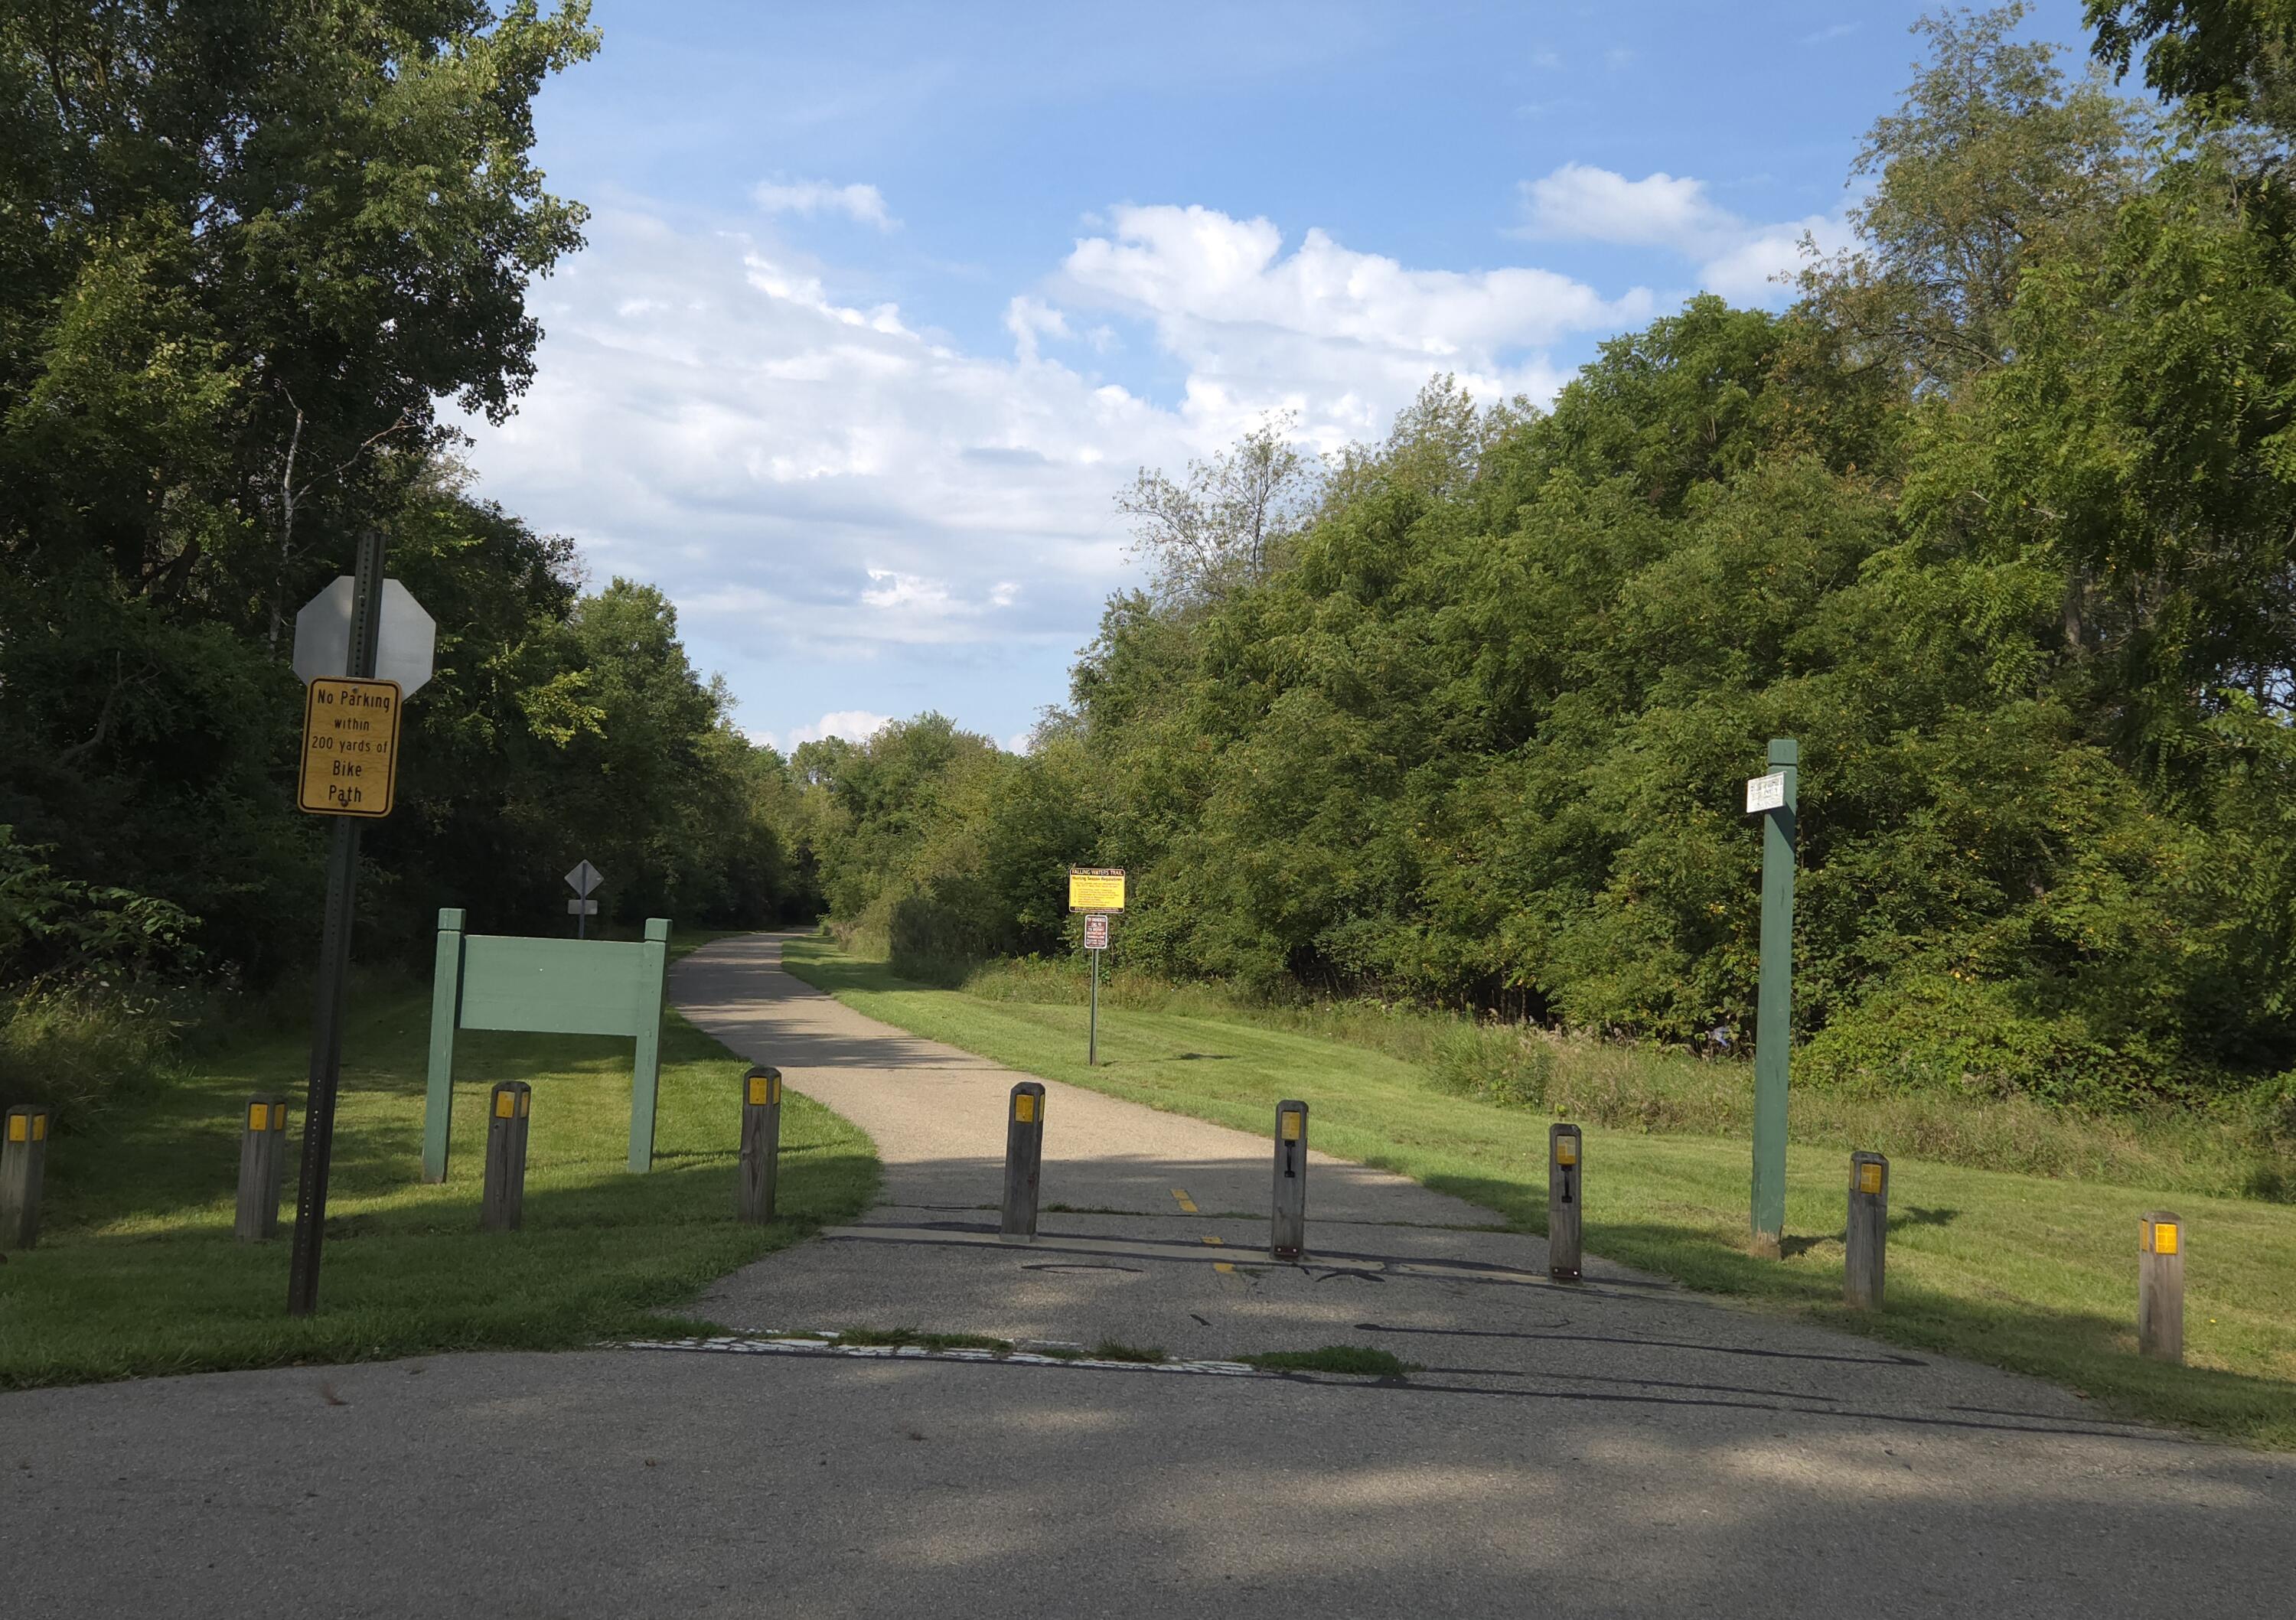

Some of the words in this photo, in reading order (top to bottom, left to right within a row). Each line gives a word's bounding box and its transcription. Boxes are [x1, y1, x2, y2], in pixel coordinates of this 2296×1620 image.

[318, 689, 334, 704] No
[341, 691, 390, 713] Parking
[334, 718, 370, 731] within
[311, 736, 333, 749] 200
[340, 739, 370, 753] yards
[377, 741, 388, 753] of
[333, 760, 362, 777] Bike
[328, 784, 362, 803] Path
